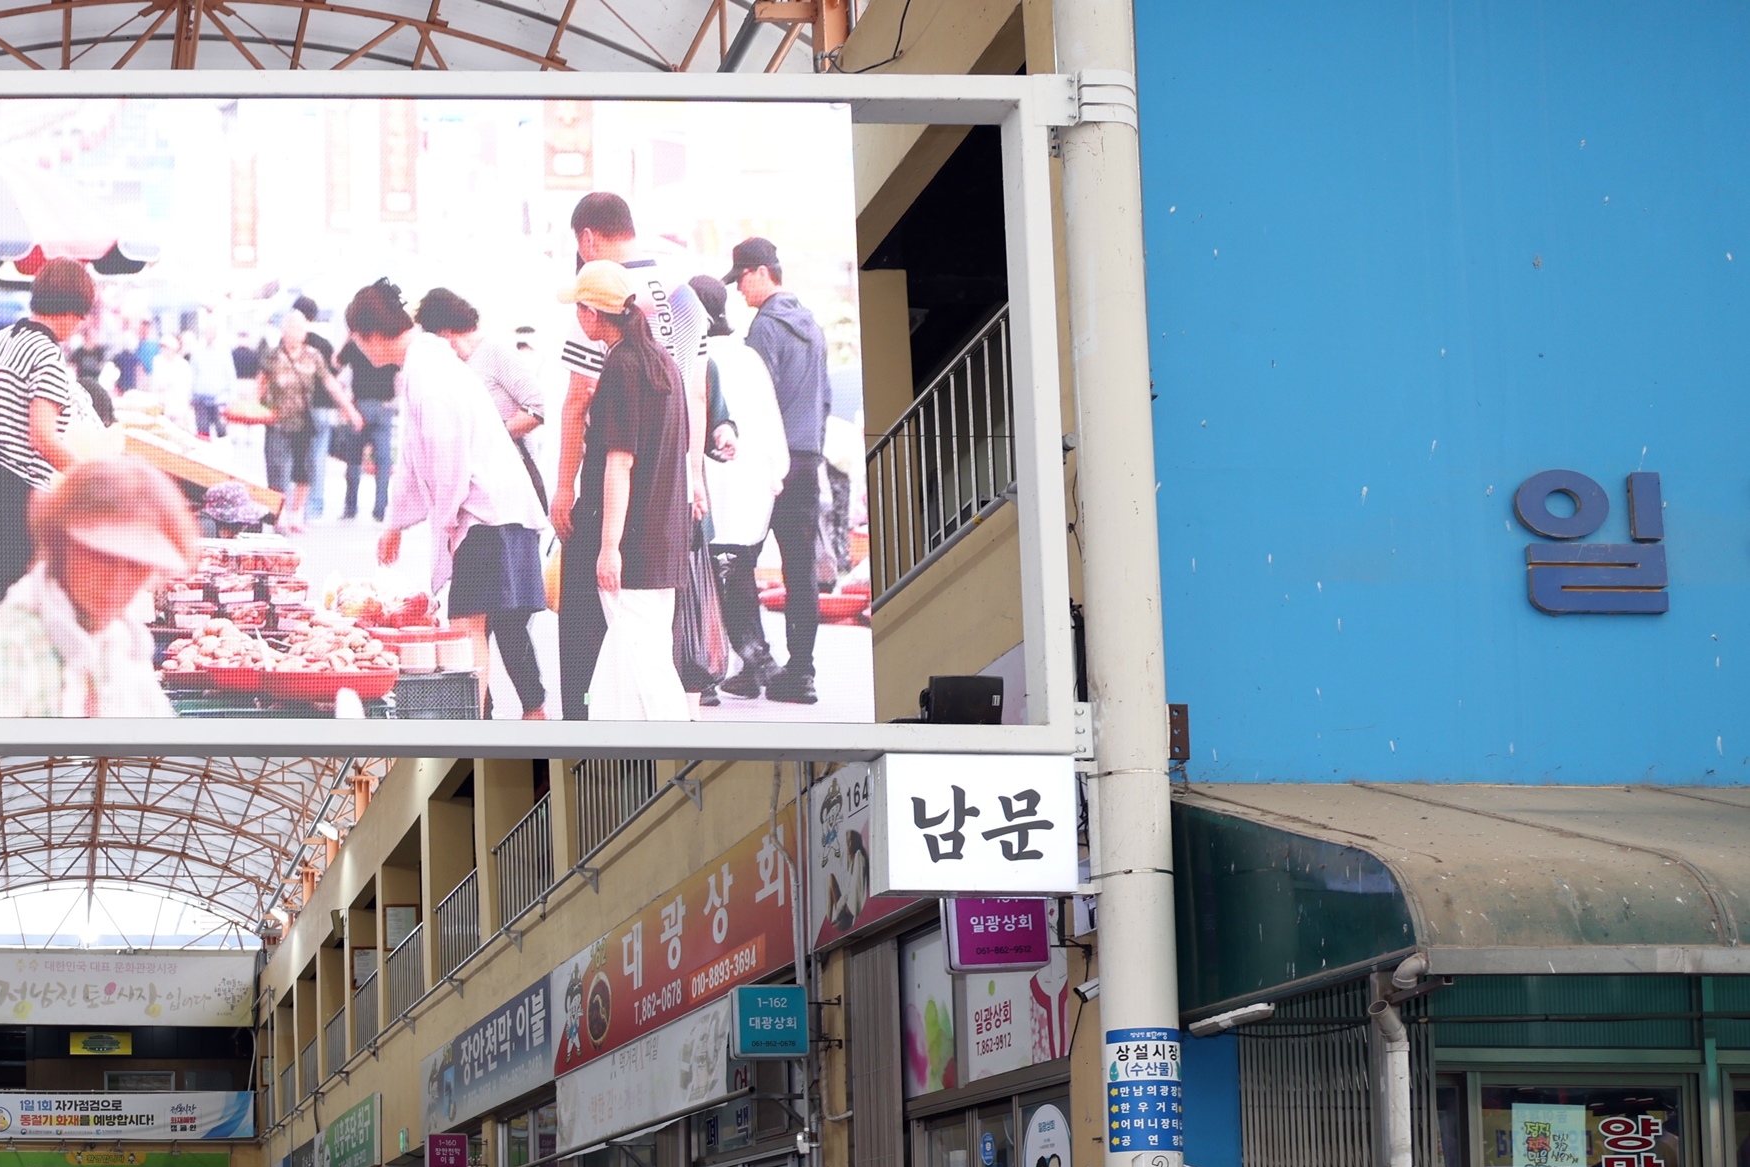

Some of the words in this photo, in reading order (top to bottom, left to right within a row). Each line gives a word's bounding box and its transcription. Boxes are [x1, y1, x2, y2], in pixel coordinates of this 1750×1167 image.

[1512, 469, 1669, 616] 일
[911, 784, 1055, 863] 남문
[621, 824, 786, 990] 대광상회
[970, 914, 1033, 933] 일광상회
[976, 945, 1032, 955] 061-862-9512
[45, 961, 87, 973] 대한민국
[90, 961, 111, 973] 대표
[114, 962, 178, 974] 문화관광시장
[691, 944, 757, 999] 010-8893-3694
[757, 997, 787, 1008] 1-162
[516, 988, 546, 1052] 이불
[749, 1017, 797, 1030] 대광상회
[974, 1000, 1012, 1035] 일광상회
[1116, 1043, 1178, 1062] 상설시장
[1125, 1061, 1174, 1078] (수산물)
[1119, 1085, 1178, 1098] 만남의광장
[20, 1100, 35, 1111] 1일
[37, 1100, 53, 1111] 1회
[55, 1099, 123, 1112] 자가점검으로
[1120, 1102, 1179, 1114] 한우거리
[20, 1114, 53, 1126] 동절기
[56, 1114, 92, 1127] 화재를
[93, 1114, 154, 1127] 예방합시다!
[170, 1116, 197, 1124] 화재예방
[1038, 1119, 1055, 1133] 일광상회
[1120, 1118, 1179, 1130] 어머니장터
[1524, 1121, 1550, 1137] 정직
[1121, 1134, 1180, 1147] 공연장
[435, 1147, 461, 1156] 장안천막
[86, 1154, 125, 1163] 환영합니다
[440, 1156, 456, 1164] 이불
